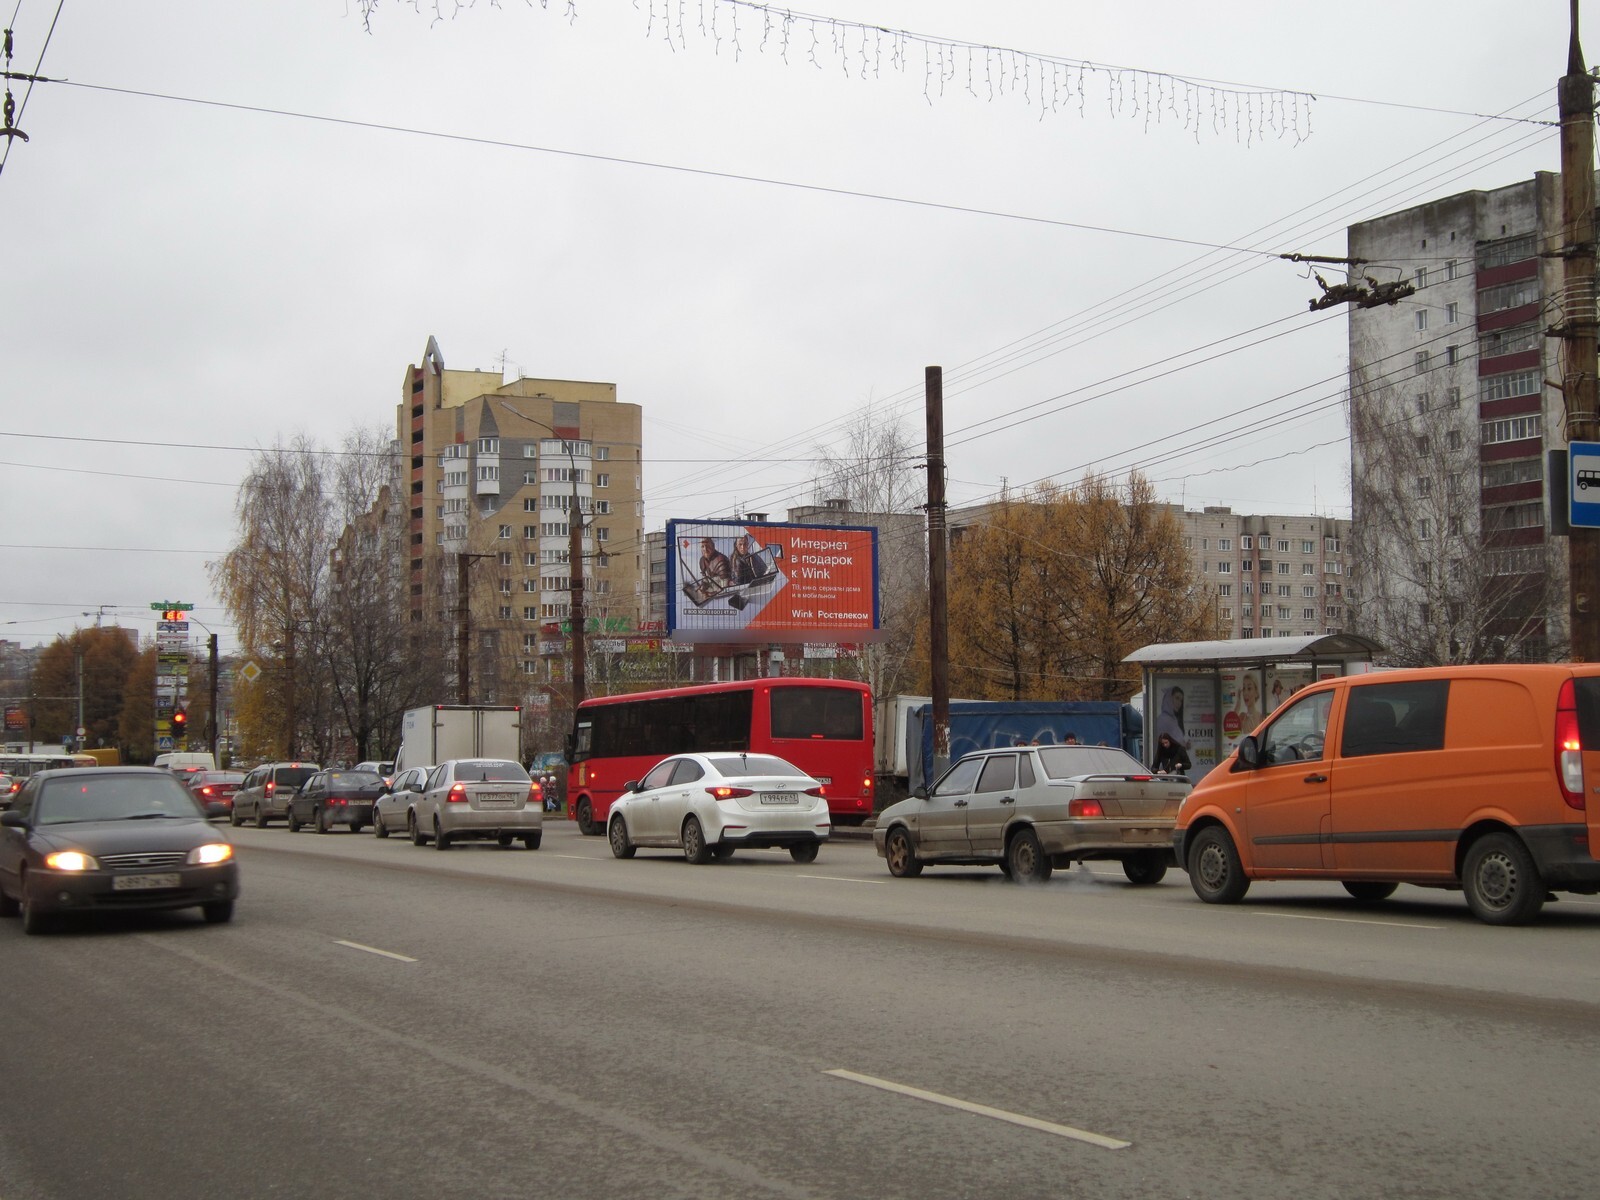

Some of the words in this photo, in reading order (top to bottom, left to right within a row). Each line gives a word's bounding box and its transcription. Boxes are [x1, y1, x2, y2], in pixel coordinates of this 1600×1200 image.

[791, 537, 848, 551] Интернет
[791, 554, 798, 563] в
[802, 555, 852, 567] подарок
[791, 569, 798, 578] к
[802, 567, 830, 579] Wink
[791, 609, 813, 618] Wink
[818, 610, 868, 620] Ростелеком
